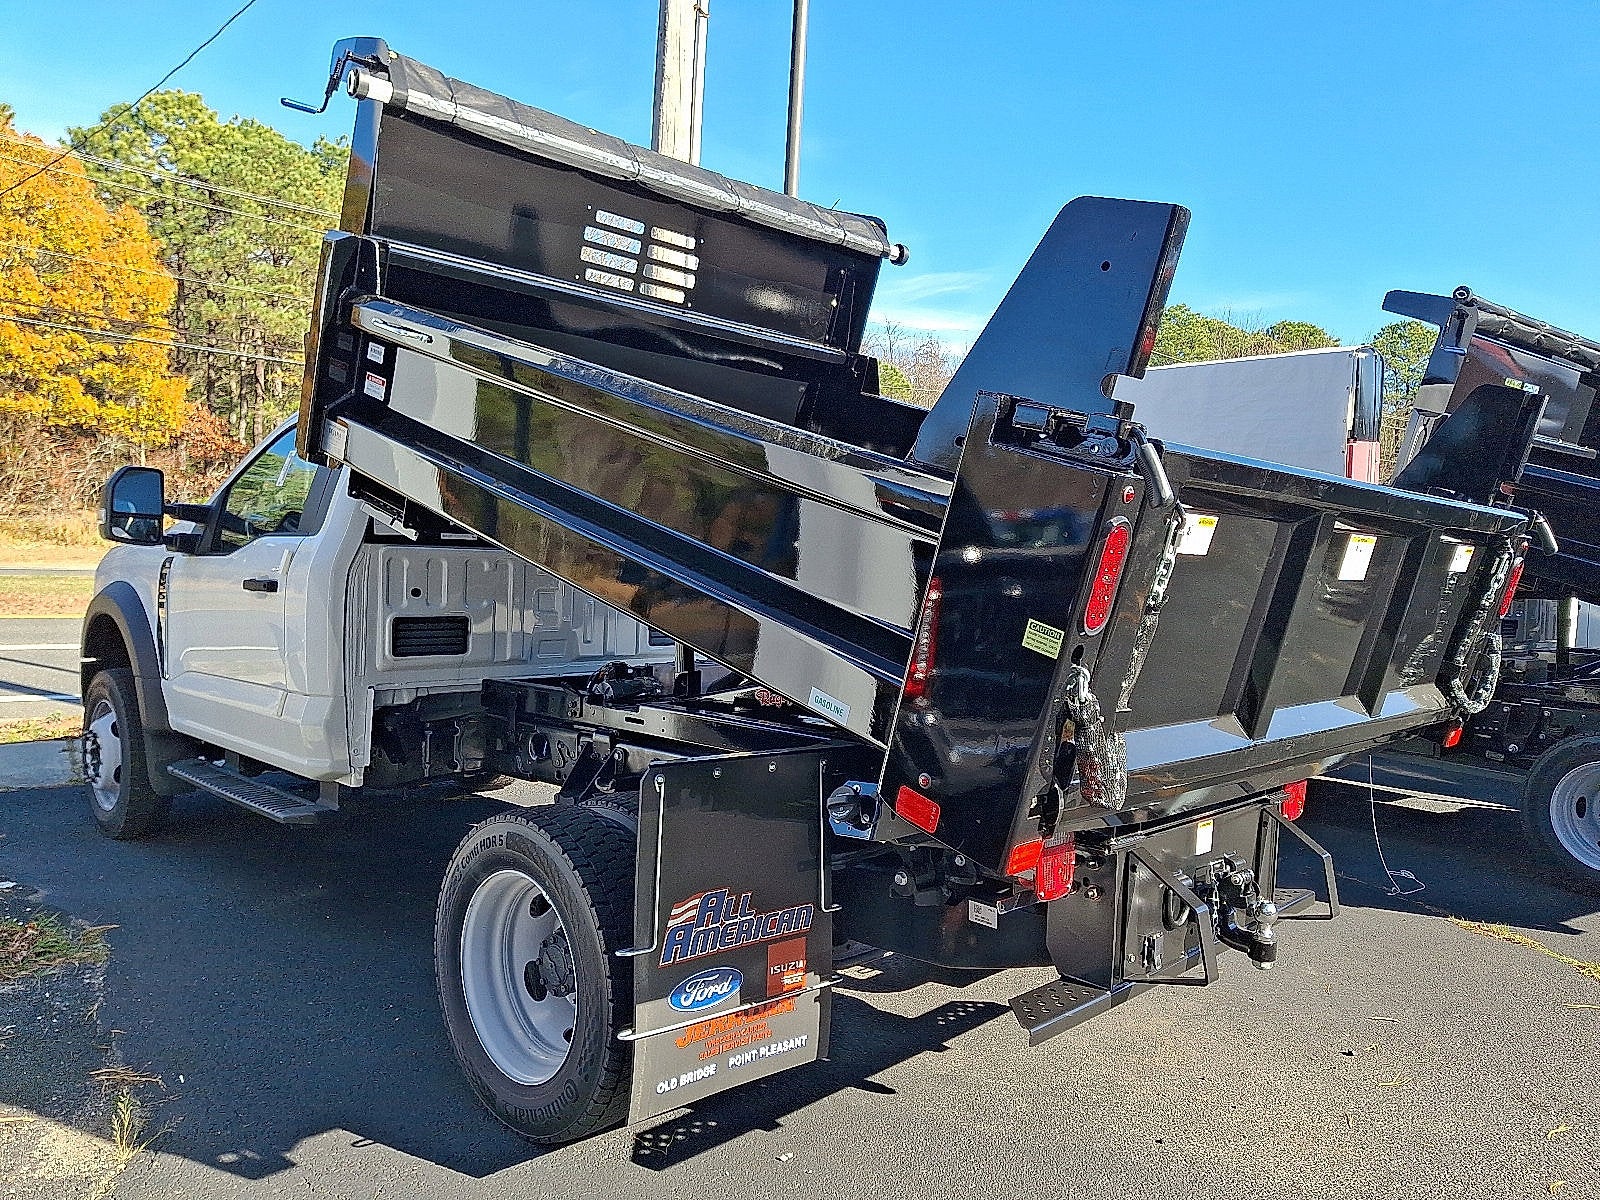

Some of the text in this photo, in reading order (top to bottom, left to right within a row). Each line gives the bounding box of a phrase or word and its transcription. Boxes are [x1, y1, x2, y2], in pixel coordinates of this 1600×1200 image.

[1030, 622, 1061, 640] CAUTION
[814, 695, 844, 717] GASOLINE
[660, 903, 814, 965] AMERICAN
[770, 960, 804, 975] ISUZU
[680, 973, 732, 1007] Ford
[728, 1034, 808, 1069] POINT PLEASANT
[656, 1062, 718, 1094] OLD BRIDGE
